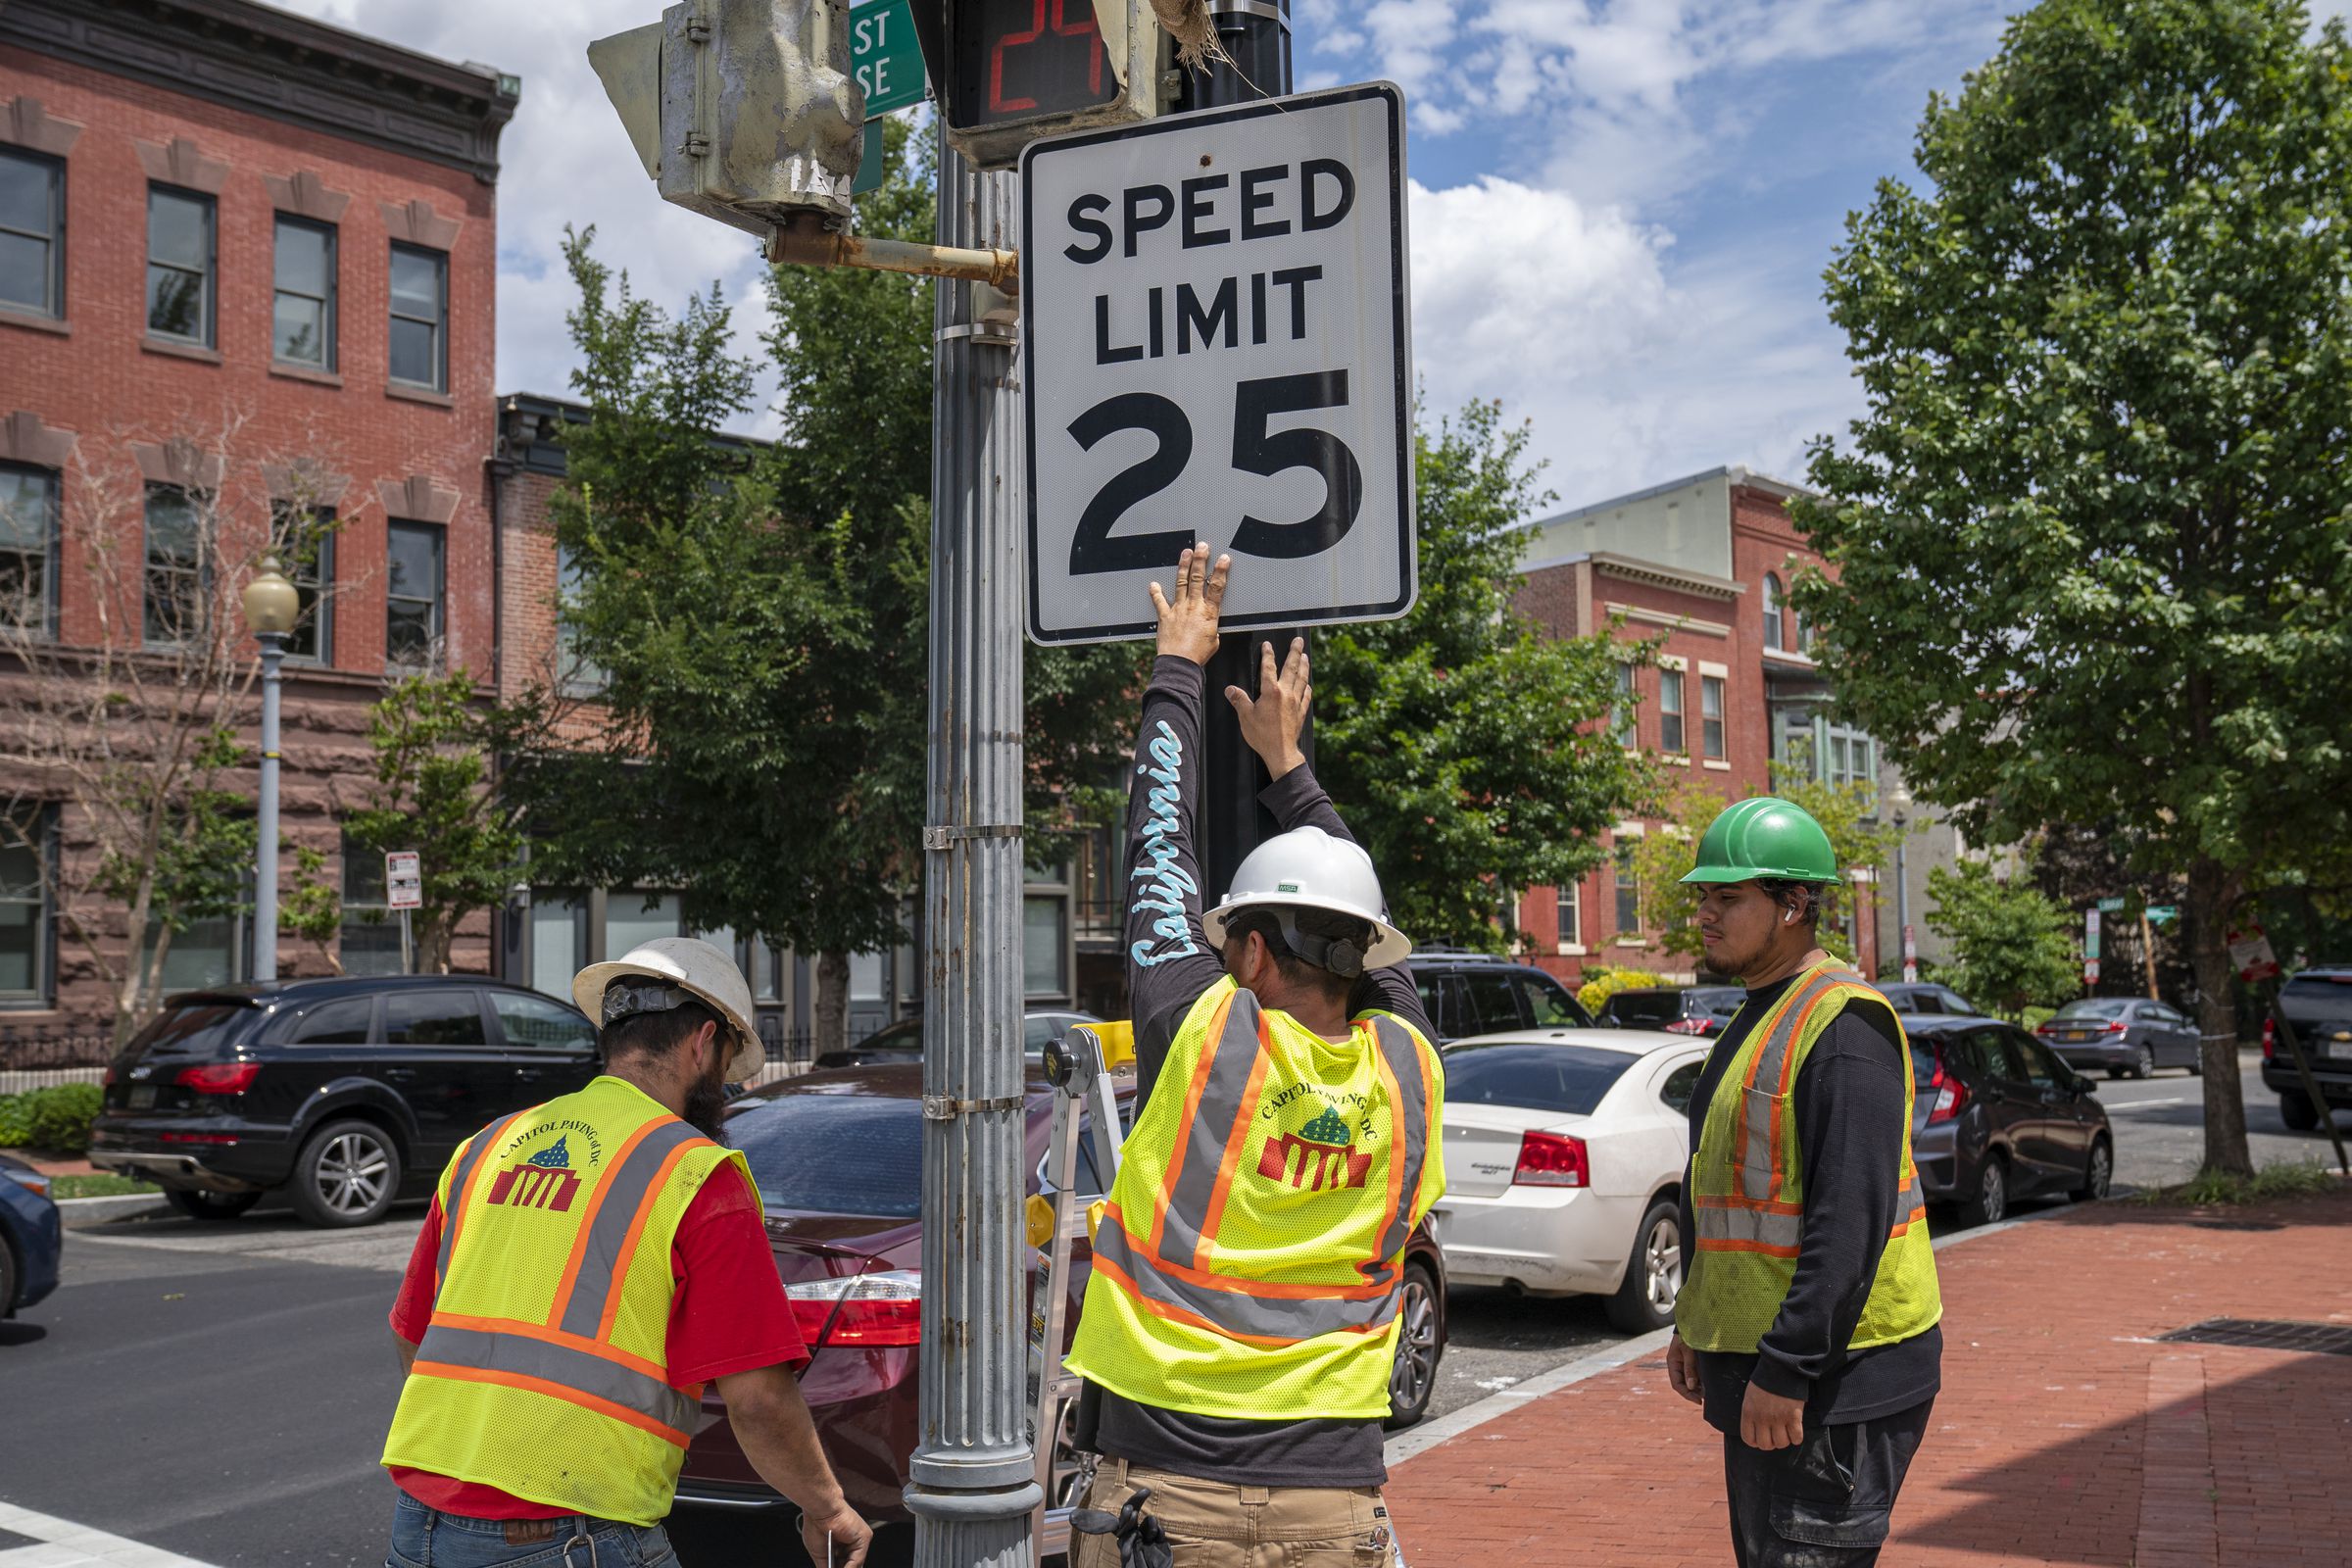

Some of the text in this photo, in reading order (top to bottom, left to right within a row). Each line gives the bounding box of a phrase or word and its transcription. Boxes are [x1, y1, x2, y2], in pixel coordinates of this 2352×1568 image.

[854, 11, 891, 55] ST
[856, 57, 891, 100] SE
[1063, 158, 1356, 265] SPEED
[1096, 265, 1323, 366] LIMIT
[1066, 368, 1363, 575] 25
[1131, 720, 1200, 967] California
[501, 1121, 559, 1158] CAPITOL
[561, 1119, 598, 1141] PAVING
[588, 1151, 602, 1167] DC
[1358, 1117, 1378, 1141] DC
